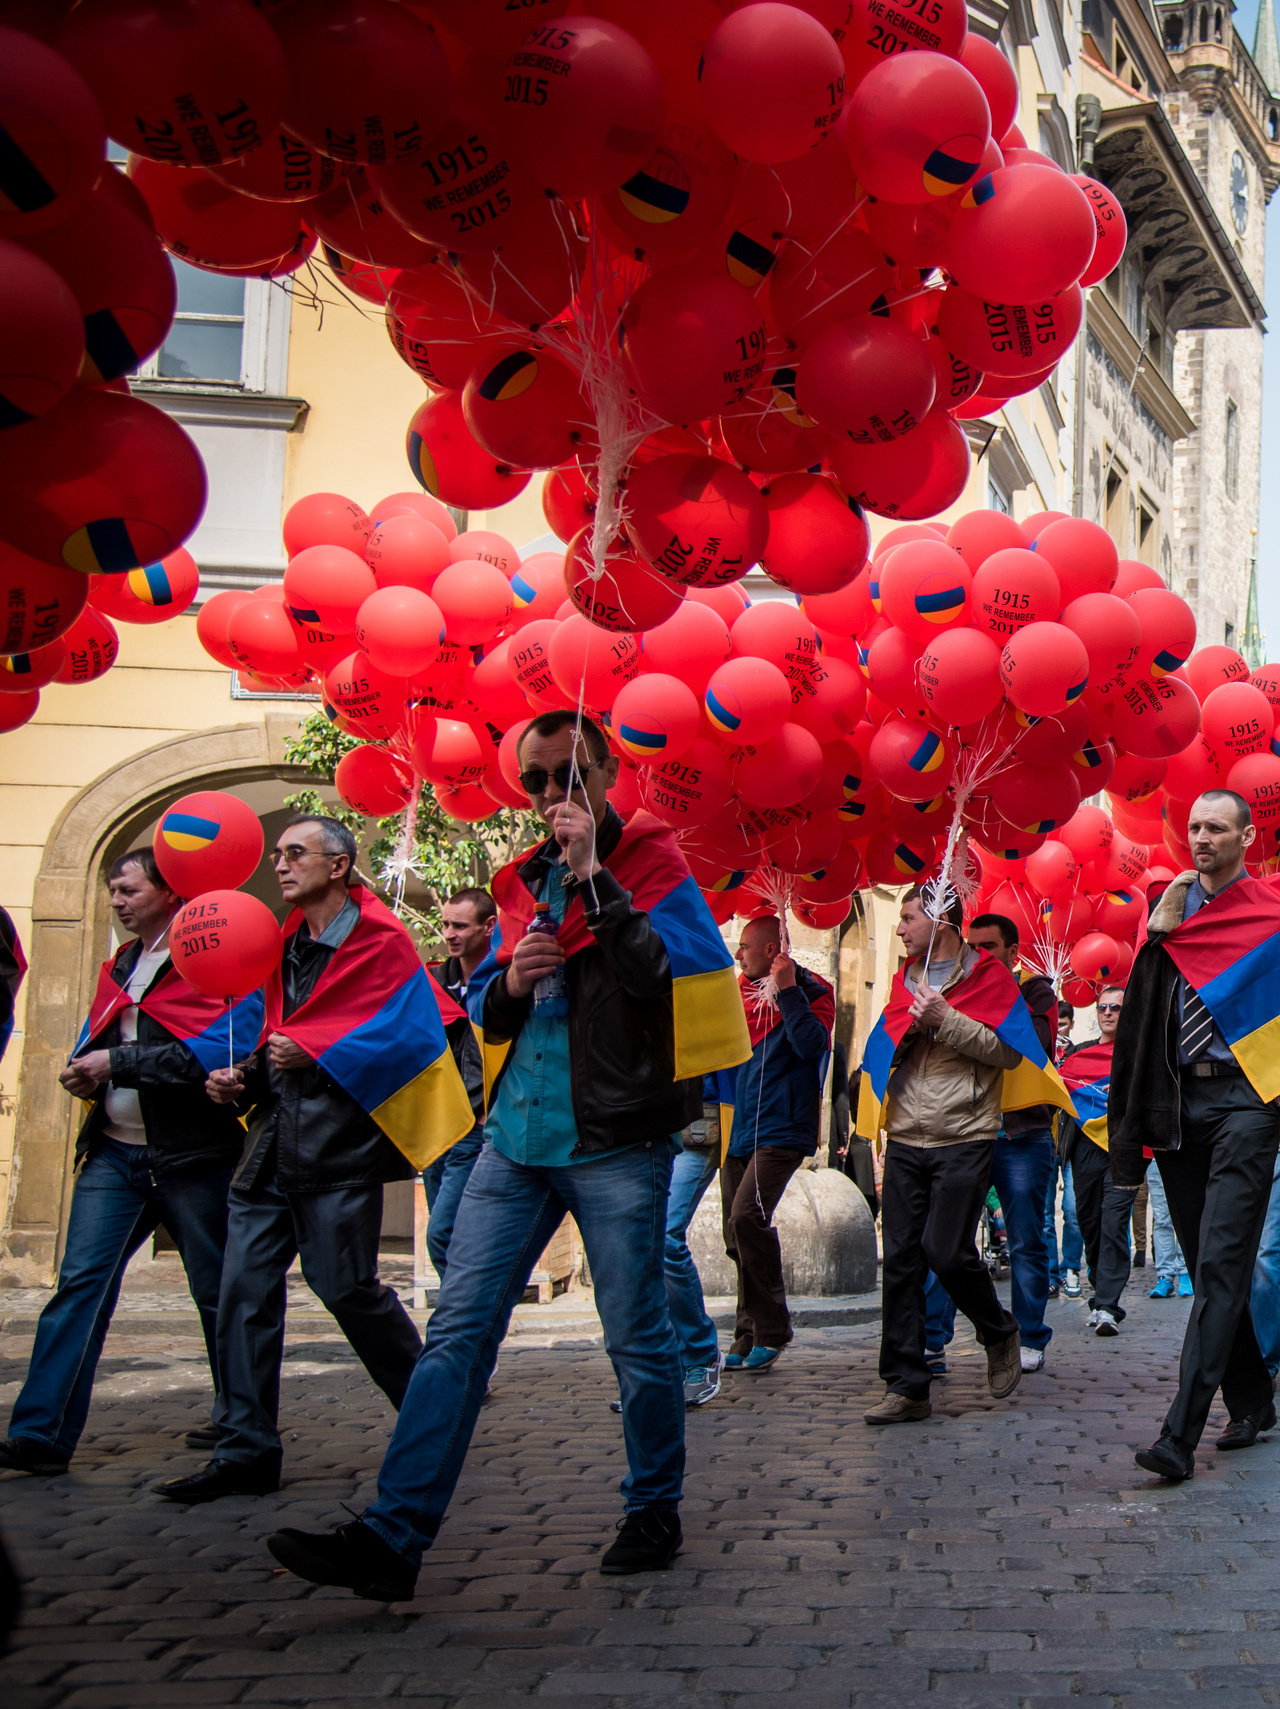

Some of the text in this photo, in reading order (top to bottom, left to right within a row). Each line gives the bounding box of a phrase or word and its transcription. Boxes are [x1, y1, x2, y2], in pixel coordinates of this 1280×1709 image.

[885, 9, 941, 50] REMEMBER
[867, 26, 918, 55] 201
[173, 92, 202, 123] WE
[134, 113, 190, 167] 201
[421, 136, 487, 186] 1915
[424, 161, 511, 211] WE REMEMBER
[451, 189, 511, 232] 2015
[1081, 182, 1116, 221] 1915
[984, 300, 1013, 352] 2015
[1034, 303, 1056, 344] 915
[735, 320, 768, 362] 191
[724, 368, 742, 384] WE
[702, 537, 722, 556] WE
[9, 587, 26, 608] WE
[574, 586, 620, 621] 2015
[993, 589, 1030, 609] 1915
[983, 603, 1035, 621] WE REMEMBER
[308, 629, 334, 643] 015
[71, 650, 88, 681] 2015
[512, 642, 544, 669] 1915
[785, 652, 795, 661] WE
[921, 652, 939, 671] 915
[525, 658, 549, 677] REMEMB
[612, 664, 623, 676] WE
[809, 661, 829, 682] 915
[1221, 658, 1246, 679] 1915
[336, 678, 370, 695] 1915
[529, 676, 554, 694] 201
[791, 685, 803, 704] 15
[800, 674, 817, 697] EMBER
[921, 684, 934, 700] 15
[1150, 678, 1176, 698] 915
[1251, 677, 1278, 694] 1915
[343, 692, 381, 706] REMEMBER
[1124, 688, 1147, 715] 2015
[345, 704, 380, 718] 2015
[1228, 719, 1260, 738] 1915
[1235, 730, 1266, 746] REMEMBER
[1235, 741, 1262, 756] 2015
[660, 761, 701, 785] 1915
[659, 777, 702, 800] REMEMBER
[1253, 782, 1280, 799] 1915
[653, 789, 689, 813] 2015
[778, 814, 792, 826] 15
[1130, 846, 1148, 863] 1915
[1118, 863, 1139, 880] 2015
[180, 903, 219, 924] 1915
[182, 918, 228, 936] REMEMBER
[181, 932, 220, 957] 2015
